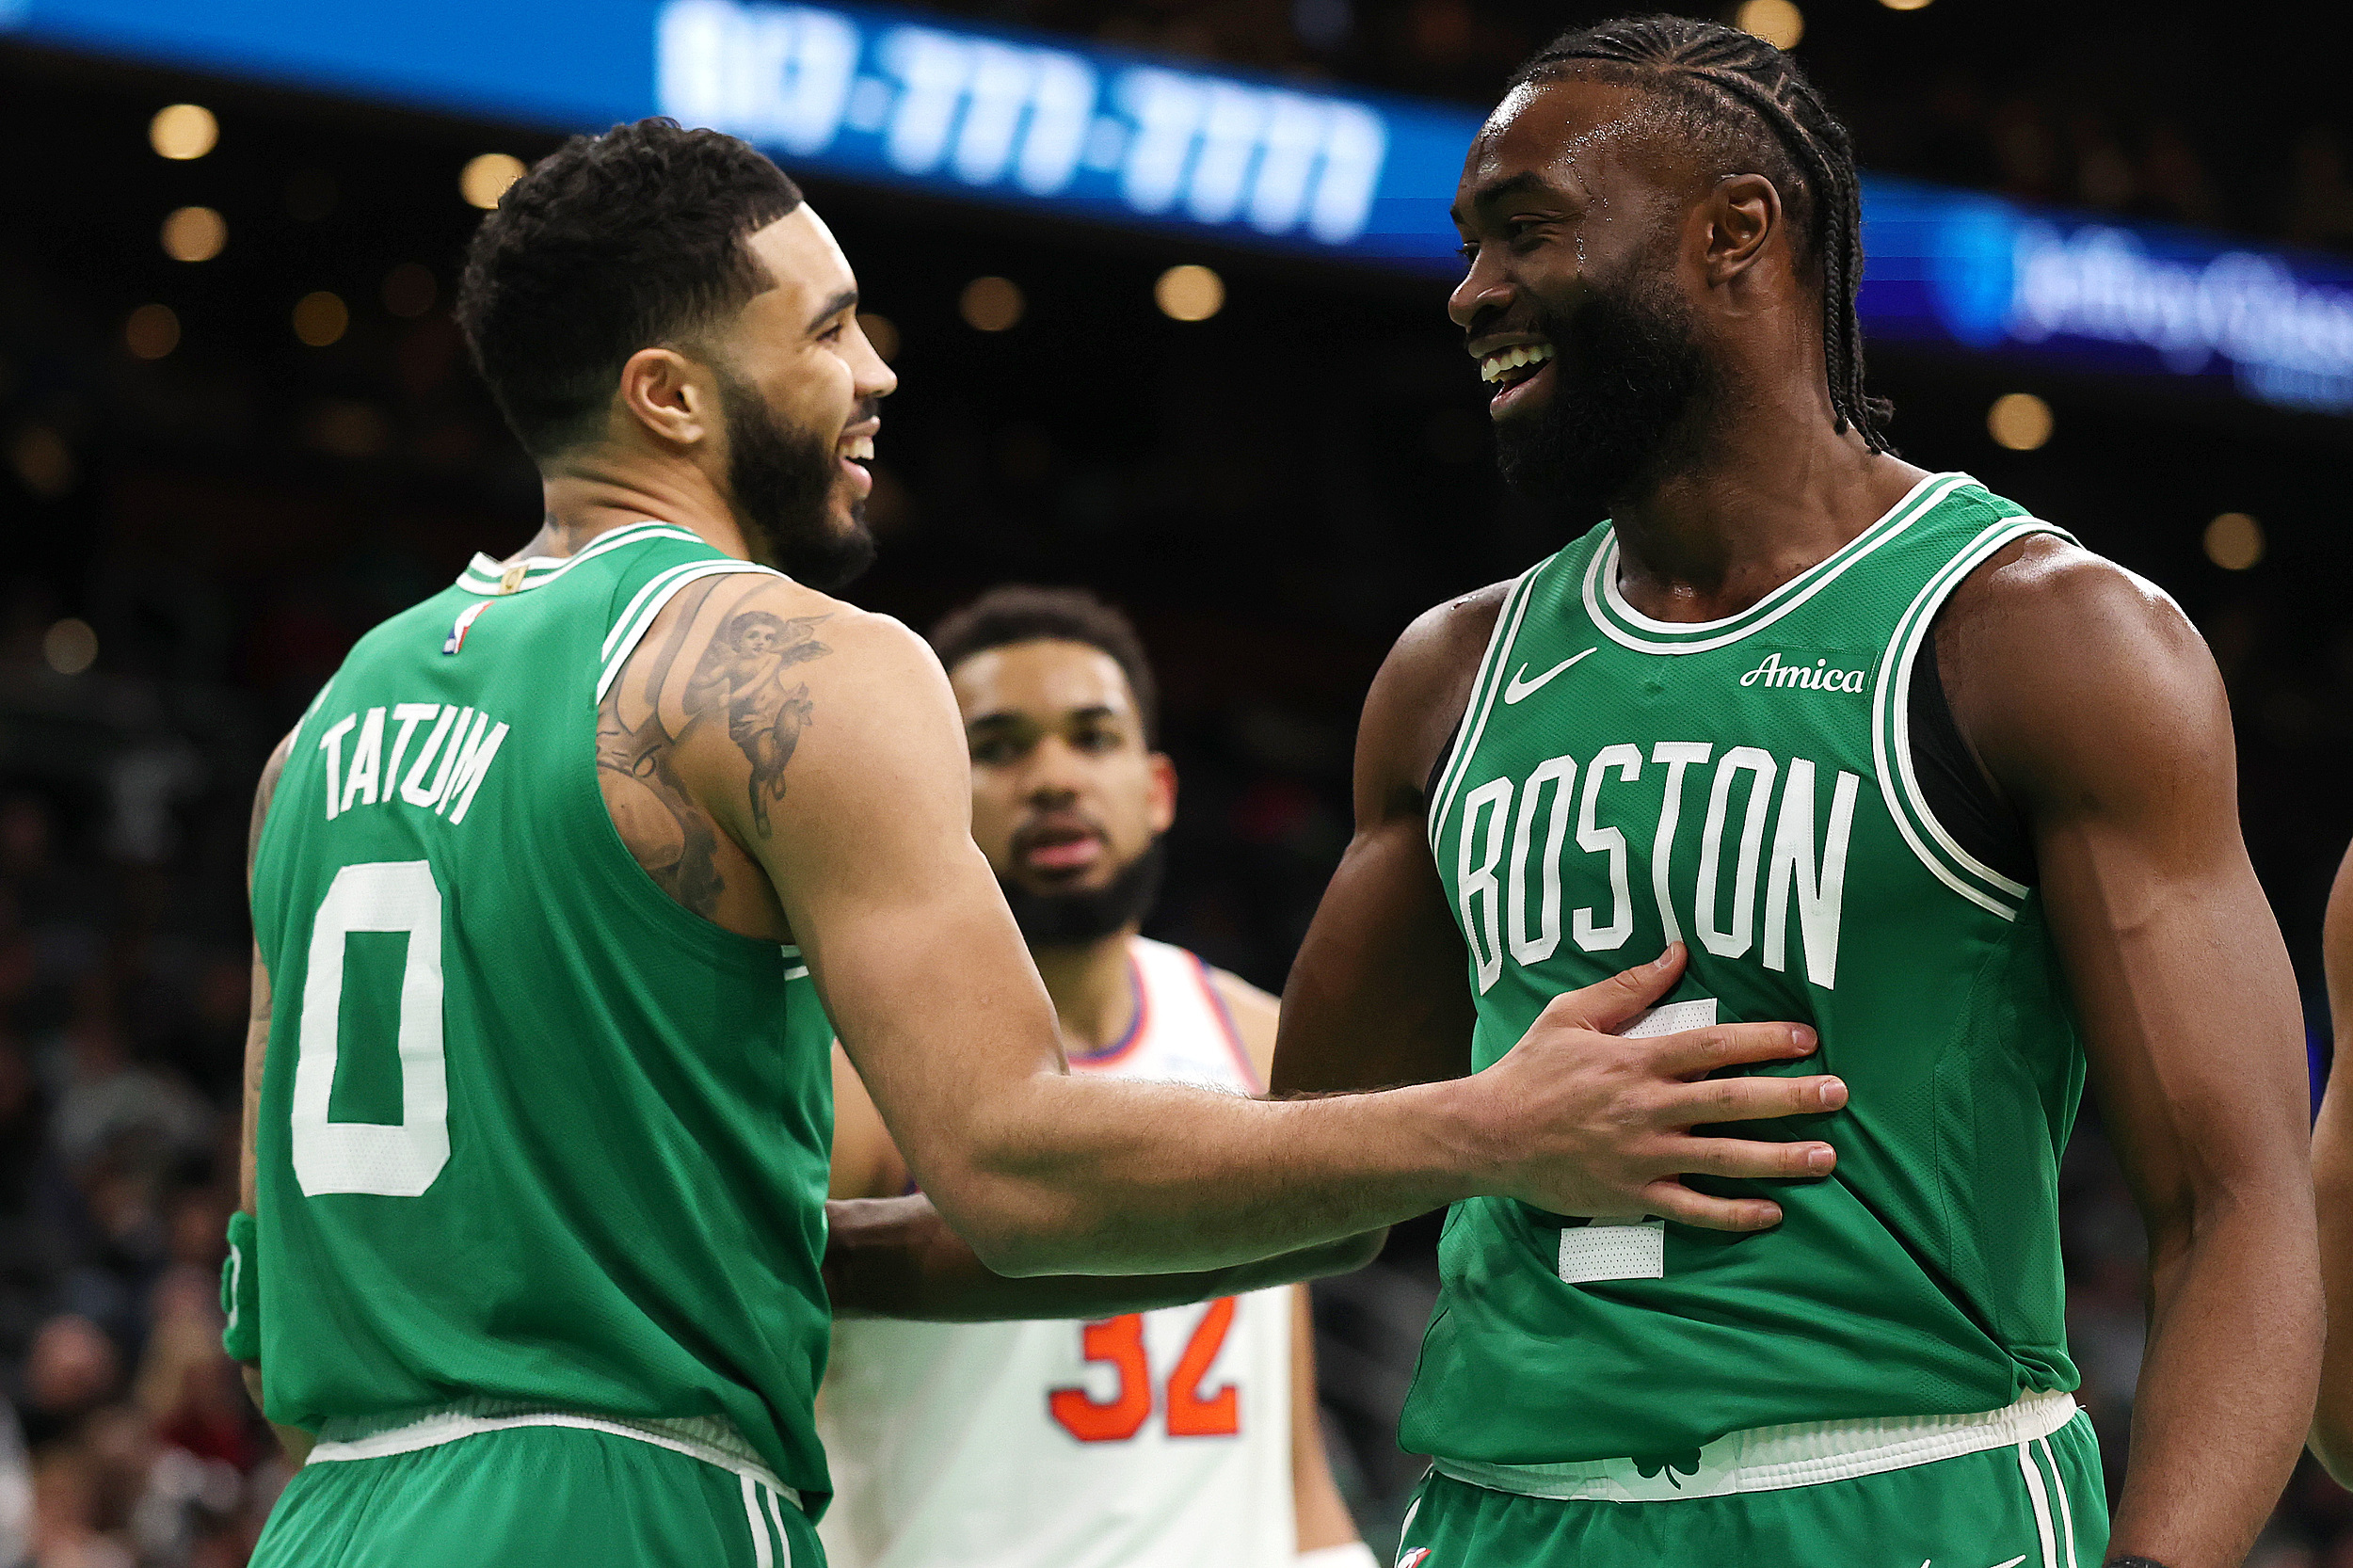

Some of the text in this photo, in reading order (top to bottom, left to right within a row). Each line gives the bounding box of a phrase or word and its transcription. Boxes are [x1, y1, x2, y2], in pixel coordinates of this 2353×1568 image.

[657, 0, 1385, 245] 7-777-7777
[319, 702, 509, 825] TATUM
[1739, 652, 1865, 694] Amica
[1458, 741, 1860, 996] BOSTON
[291, 858, 452, 1197] 0
[1048, 1295, 1240, 1443] 32
